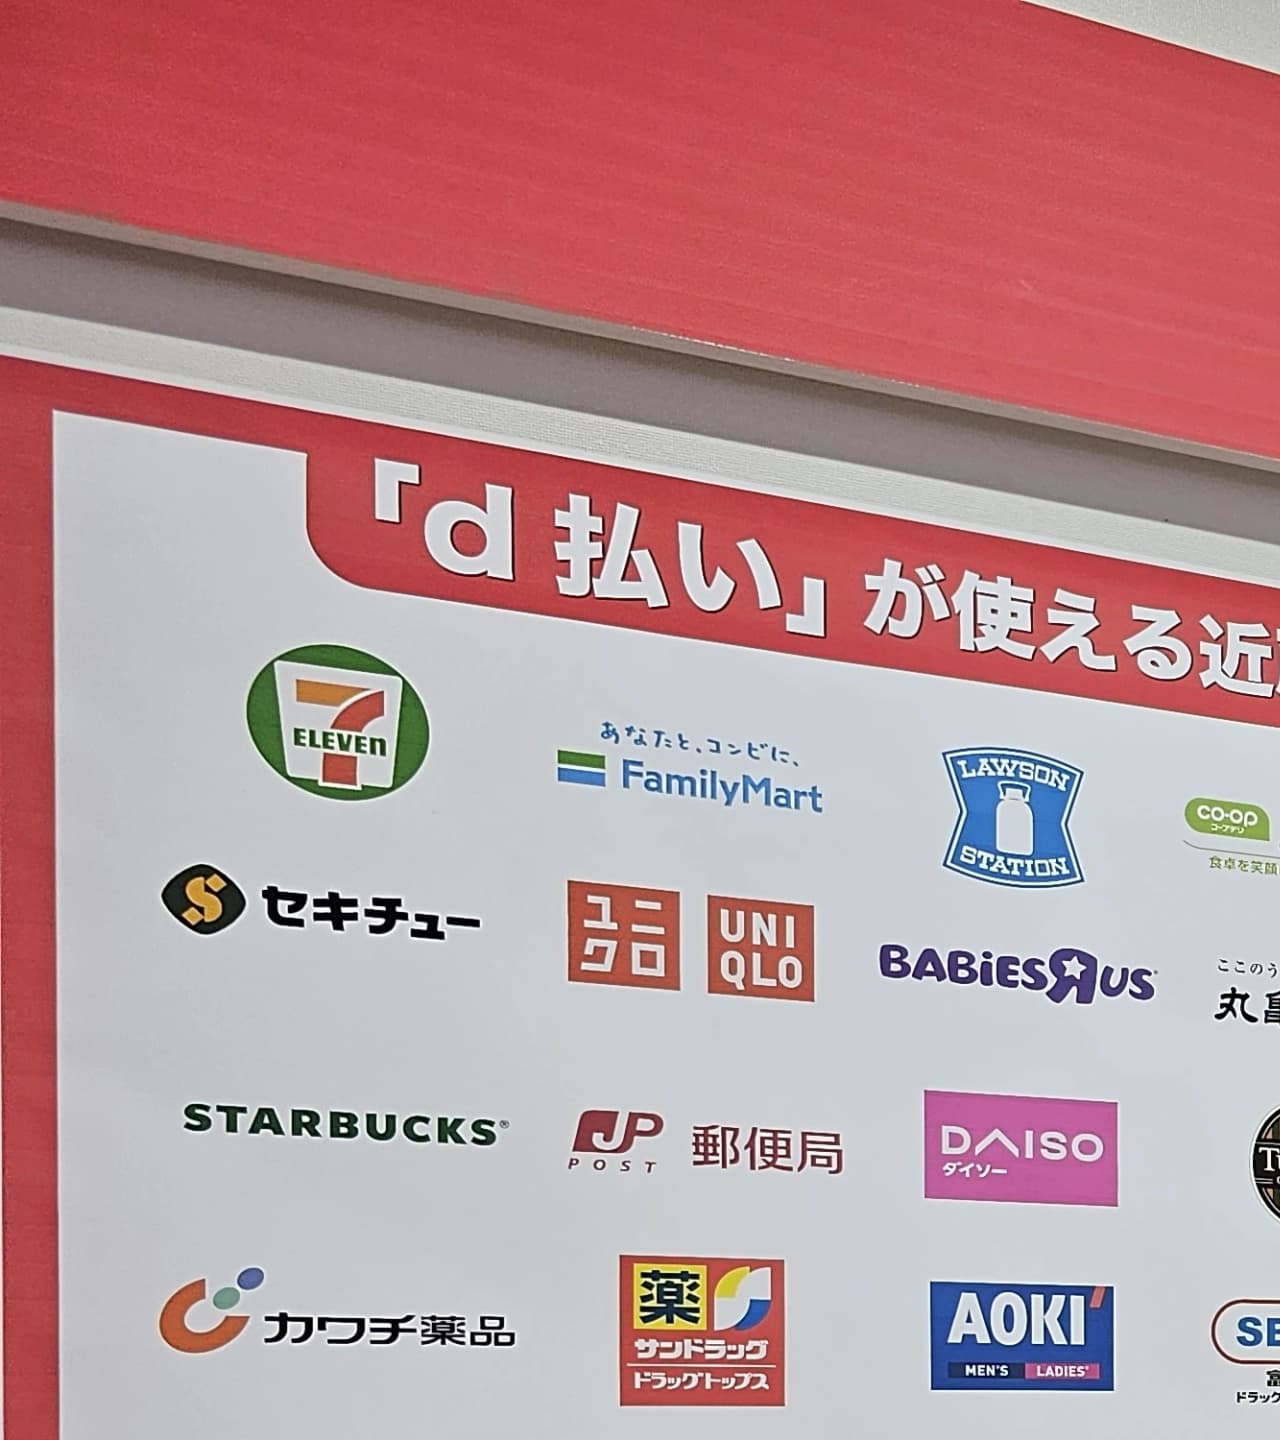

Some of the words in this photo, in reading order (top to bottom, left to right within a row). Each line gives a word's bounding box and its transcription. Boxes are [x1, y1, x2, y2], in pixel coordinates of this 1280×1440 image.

[621, 757, 826, 814] FamilyMart
[955, 756, 1072, 793] LAWSON
[957, 844, 1071, 881] STATION
[260, 884, 483, 942] セキチュー
[581, 893, 666, 934] ユニ
[717, 905, 798, 950] UNI
[580, 941, 667, 981] クロ
[717, 950, 804, 992] QLO
[690, 1122, 845, 1176] 郵便局
[940, 1124, 1105, 1164] DAISO
[566, 1155, 658, 1175] POST
[942, 1160, 1009, 1179] ダイソー
[637, 1267, 703, 1328] 薬
[262, 1310, 517, 1349] カワチ薬品
[633, 1337, 769, 1361] サンドラッグ
[633, 1369, 771, 1392] ドラッグトップス
